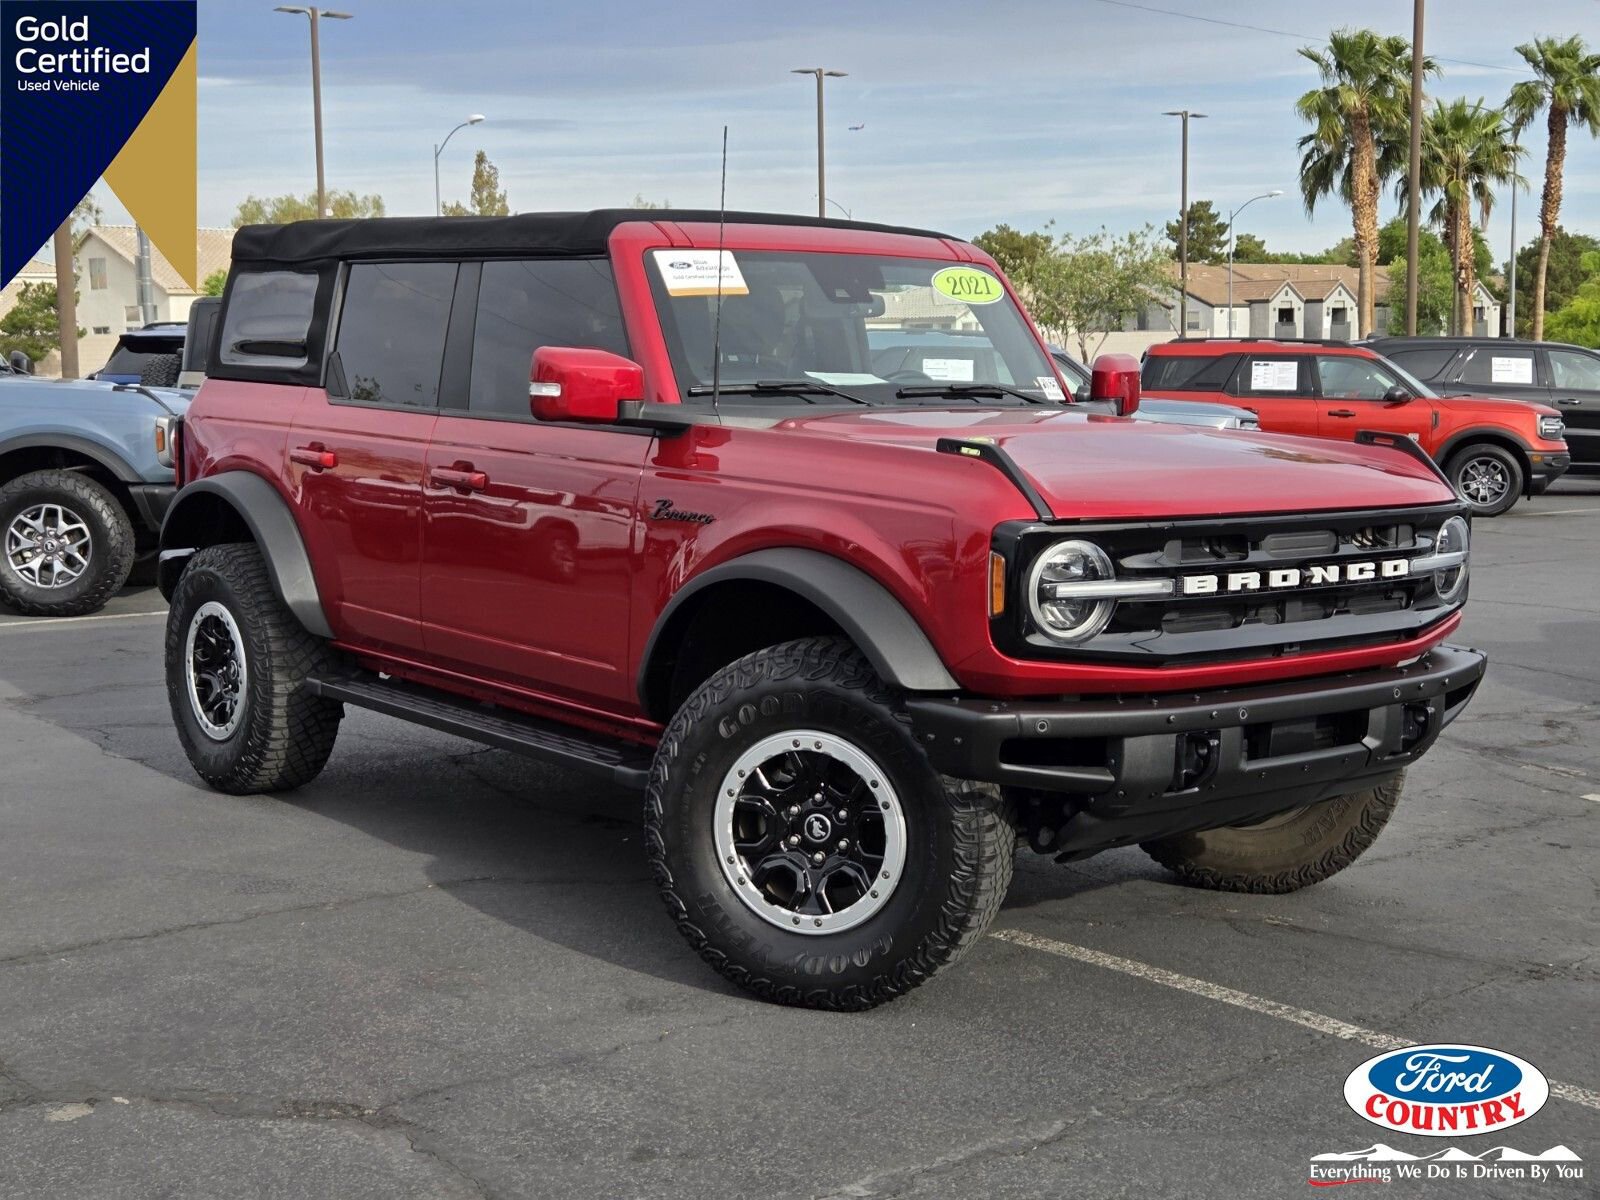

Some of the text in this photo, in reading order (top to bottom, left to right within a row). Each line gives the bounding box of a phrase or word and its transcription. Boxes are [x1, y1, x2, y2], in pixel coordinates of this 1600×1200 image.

[946, 276, 992, 296] 2021
[651, 498, 717, 524] Bronco
[1183, 558, 1410, 595] BRONCO
